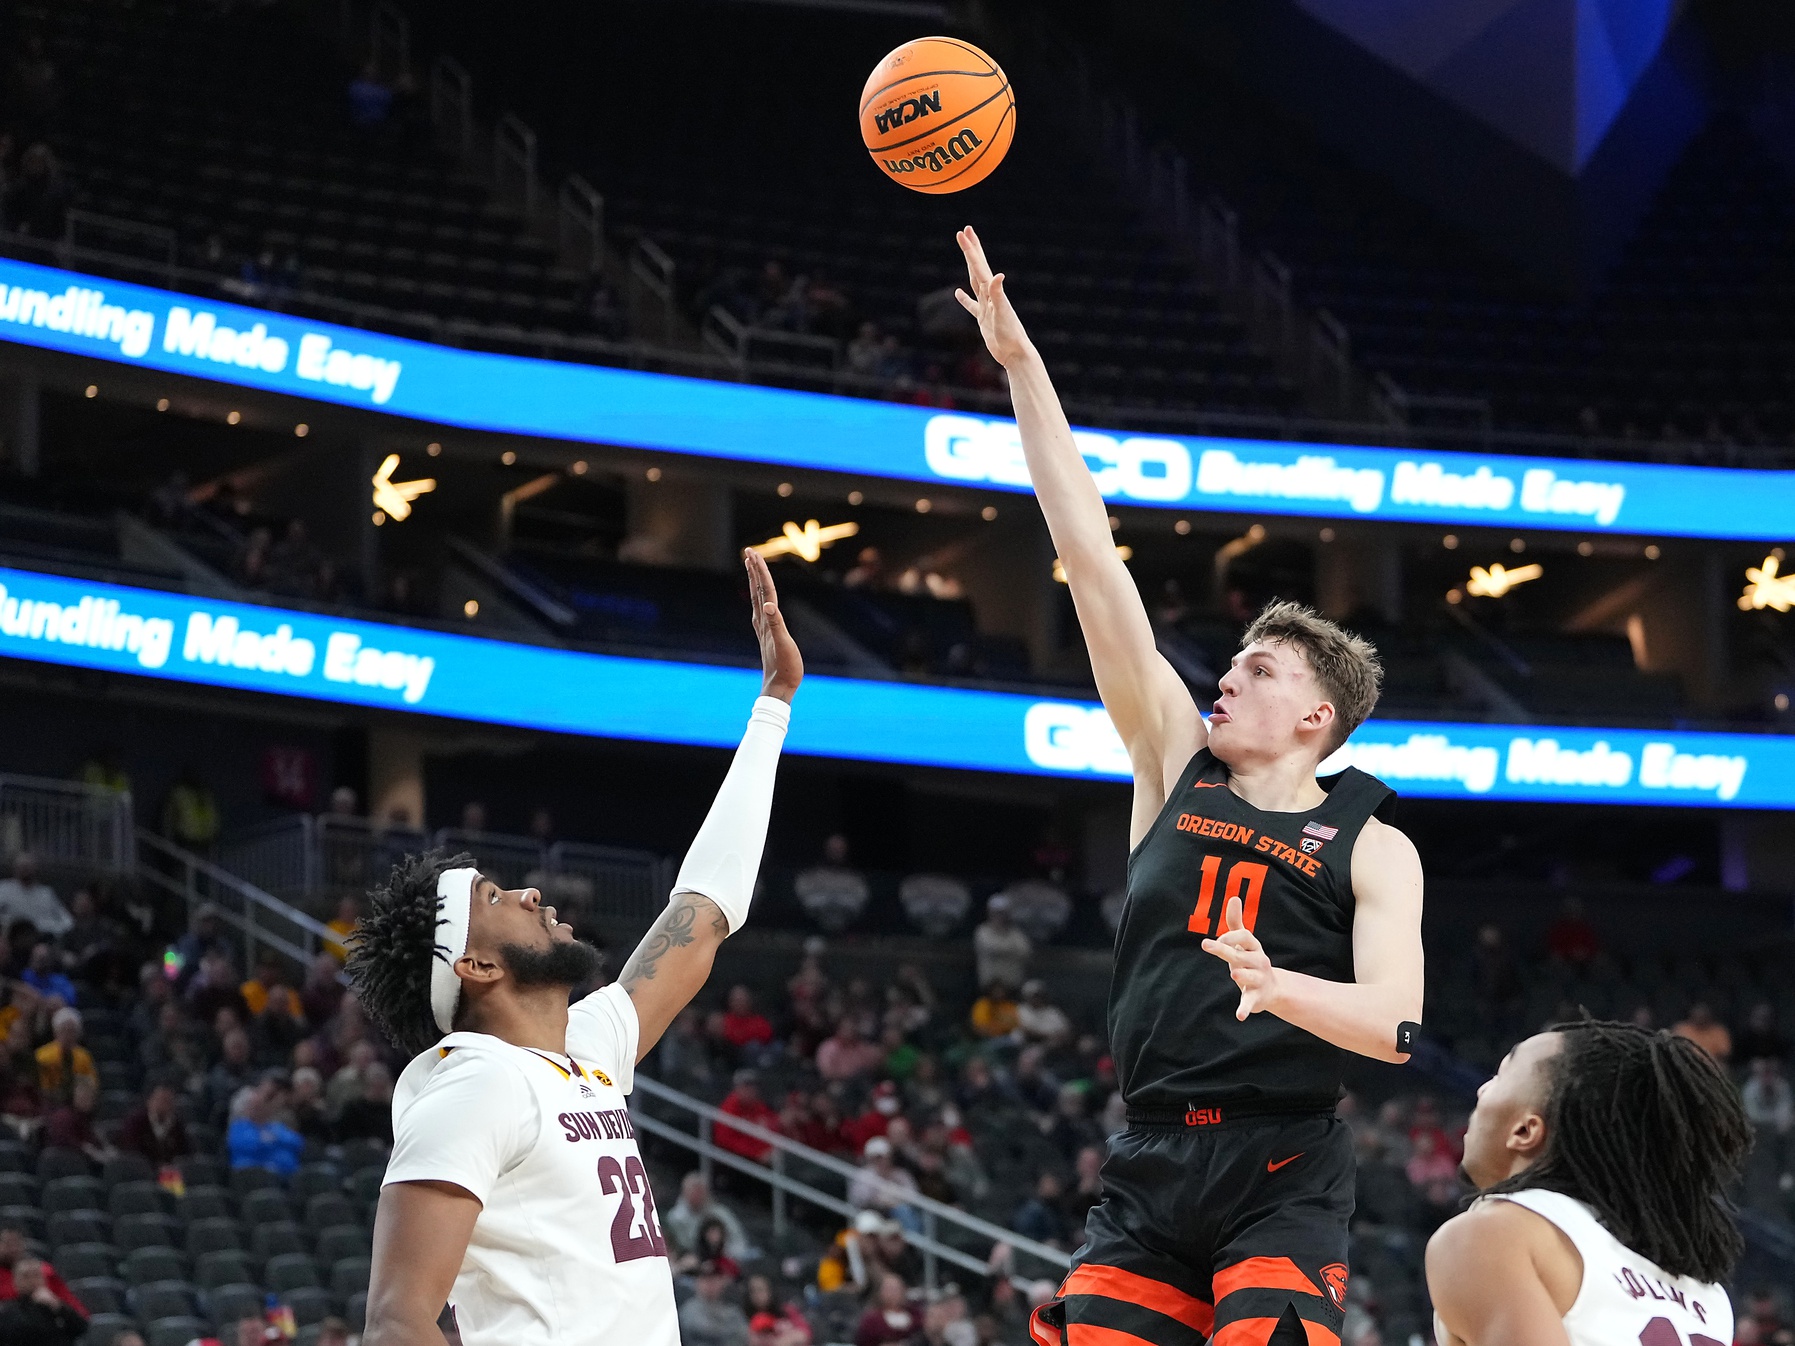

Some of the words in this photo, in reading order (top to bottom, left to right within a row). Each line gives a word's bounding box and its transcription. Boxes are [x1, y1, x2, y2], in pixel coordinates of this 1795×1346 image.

[874, 90, 942, 135] NCAA
[882, 127, 983, 173] Wilson
[163, 306, 289, 373] Made
[296, 332, 401, 405] Easy
[924, 415, 1193, 501] GECO
[1196, 450, 1385, 513] Bundling
[1391, 461, 1515, 510] Made
[1520, 469, 1626, 527] Easy
[0, 582, 174, 668] undling
[183, 611, 314, 676] Made
[323, 631, 435, 704] Easy
[1506, 738, 1632, 788] Made
[1639, 743, 1748, 801] Easy
[1176, 813, 1255, 846] OREGON
[1255, 836, 1322, 877] STATE
[1187, 855, 1269, 938] 10
[558, 1112, 602, 1143] SUN
[1185, 1108, 1222, 1126] OSU
[597, 1155, 668, 1264] 22
